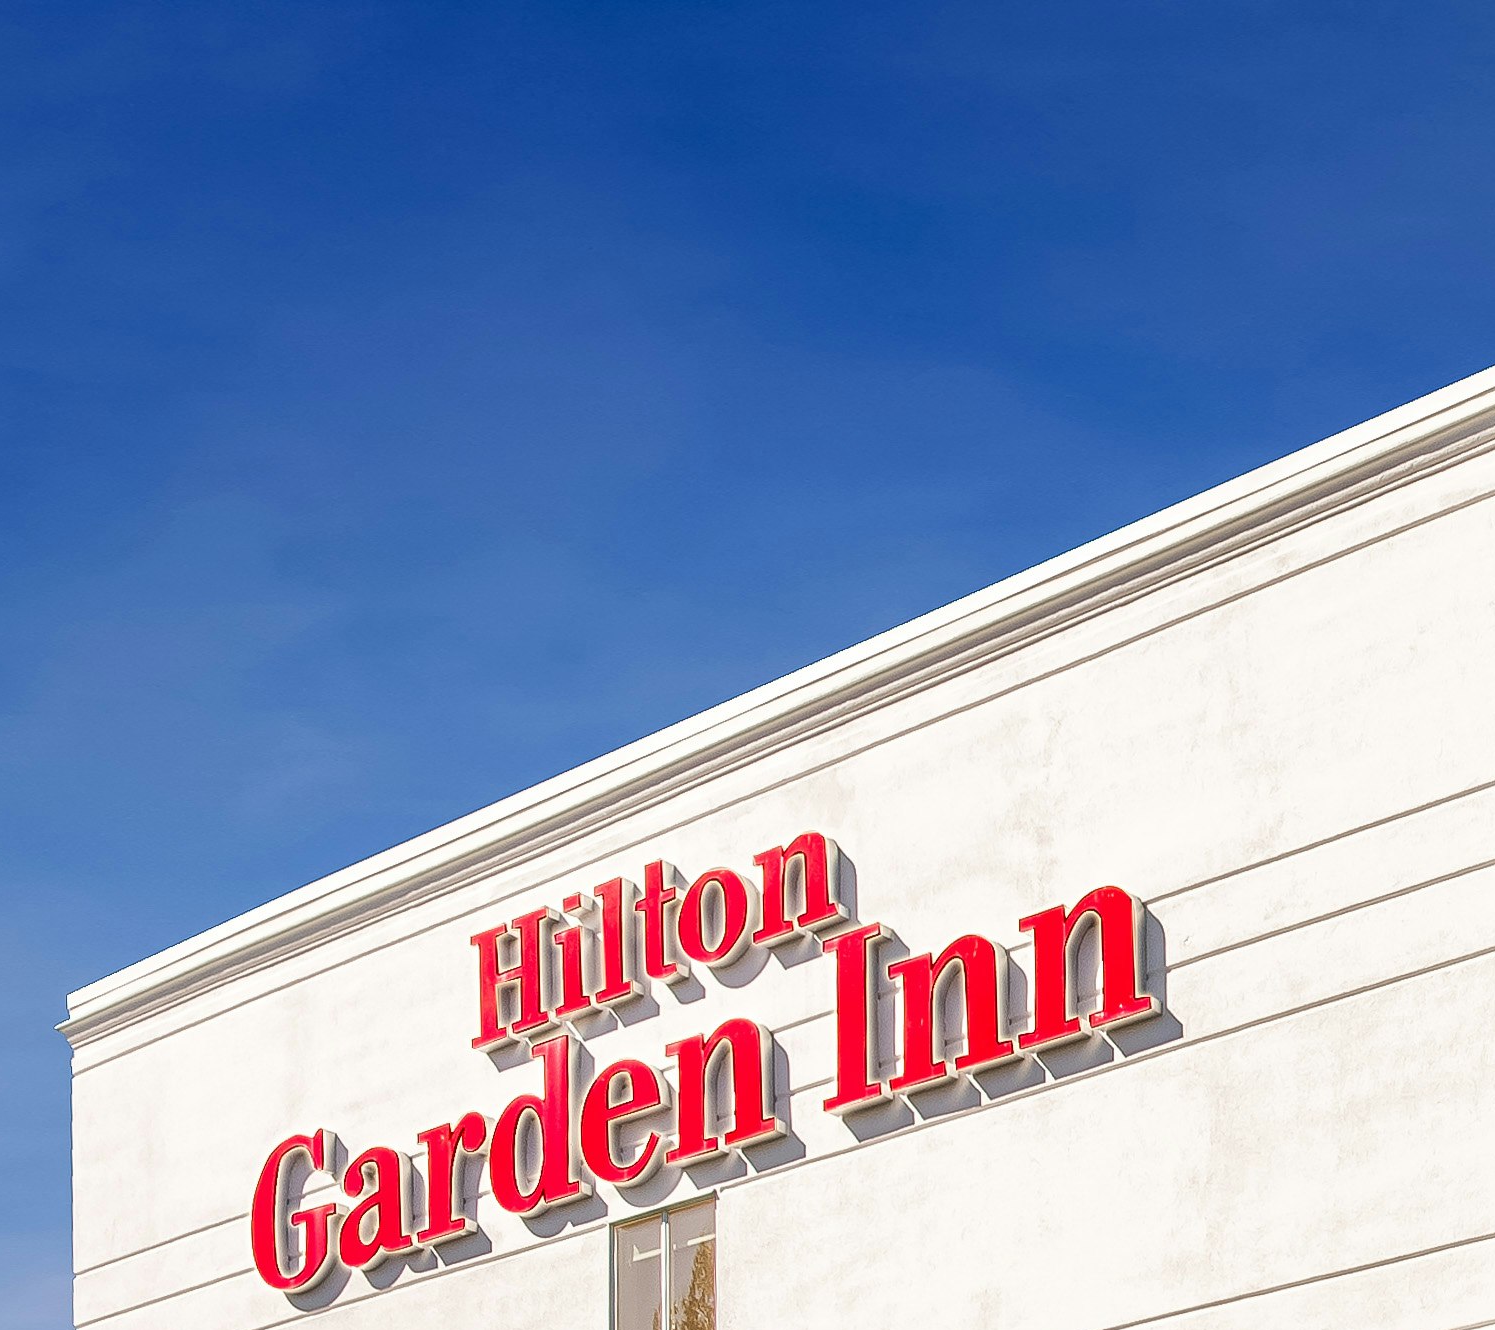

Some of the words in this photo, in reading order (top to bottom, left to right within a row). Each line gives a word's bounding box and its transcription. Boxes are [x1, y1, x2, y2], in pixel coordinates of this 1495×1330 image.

[249, 1017, 778, 1291] Garden
[821, 884, 1154, 1113] Inn
[469, 831, 841, 1050] Hilton
